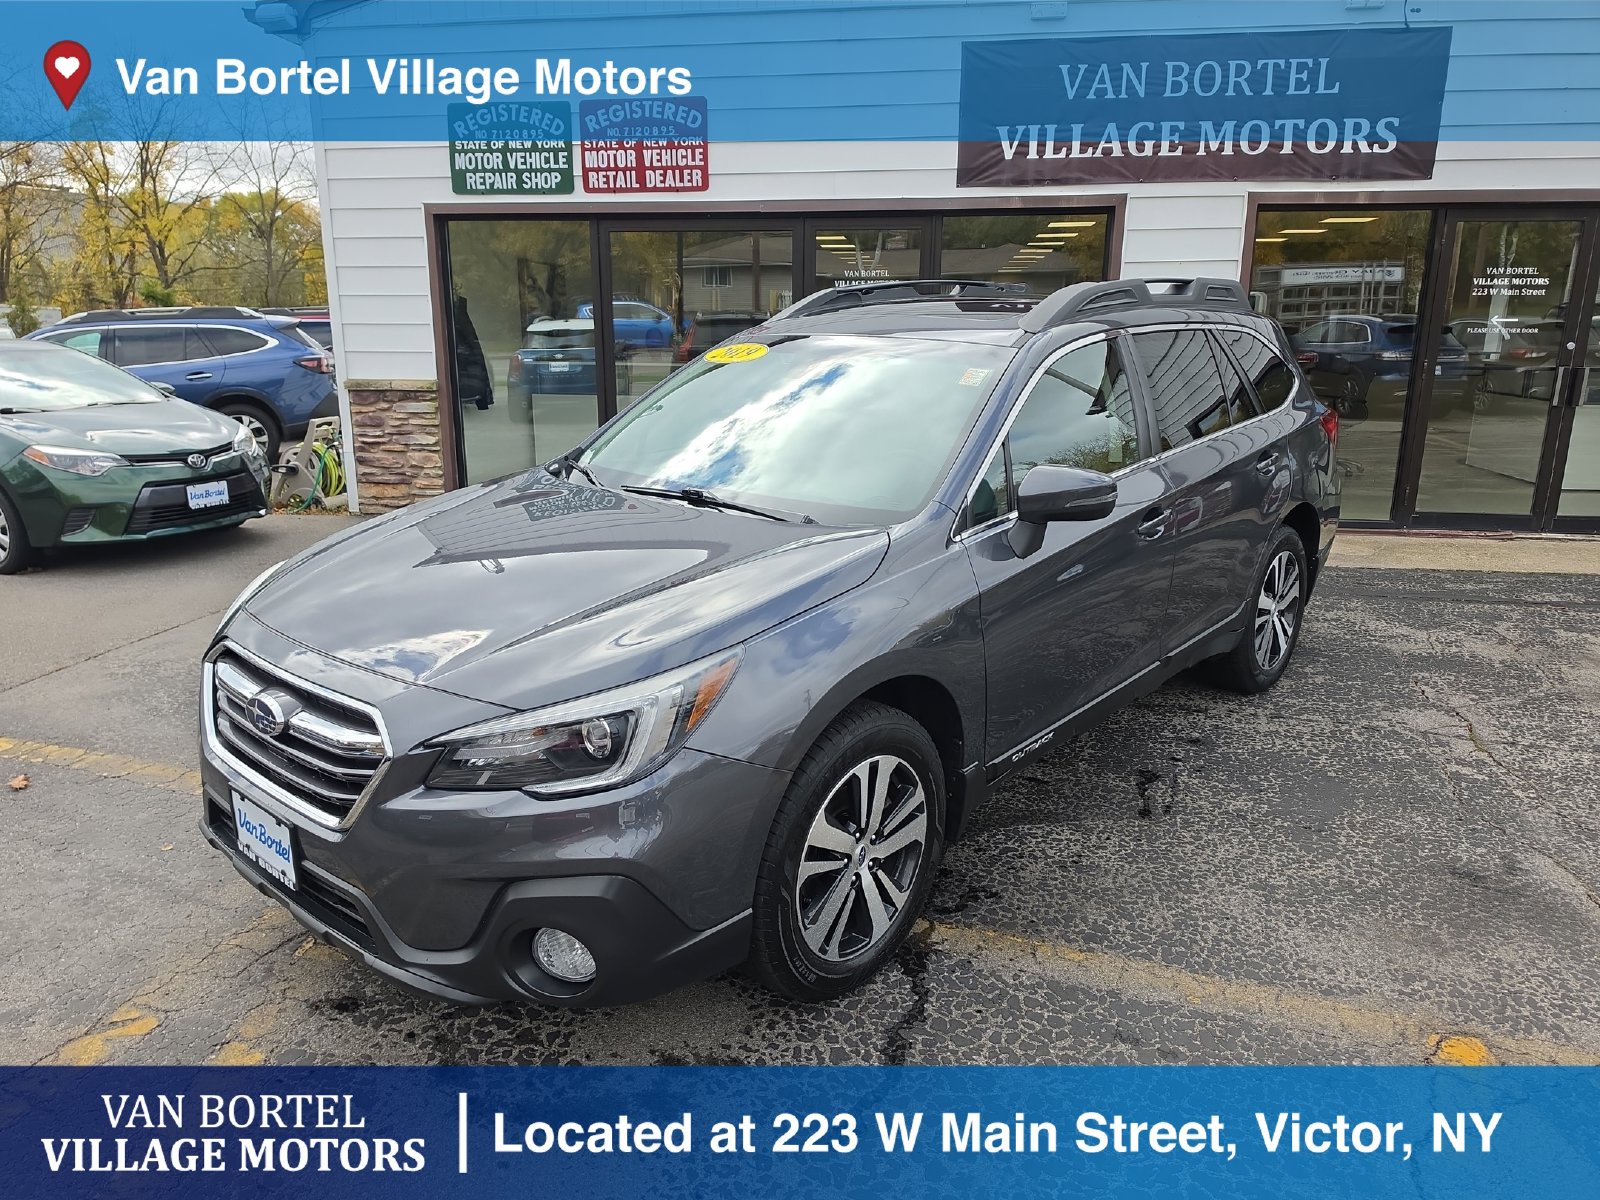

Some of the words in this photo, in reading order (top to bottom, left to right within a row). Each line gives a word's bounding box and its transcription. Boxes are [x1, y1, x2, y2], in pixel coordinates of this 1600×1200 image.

[1058, 61, 1149, 101] VAN
[1162, 57, 1340, 97] BORTEL
[453, 103, 565, 138] REGISTERED
[584, 100, 702, 133] REGISTERED
[455, 140, 488, 150] STATE
[490, 140, 505, 149] OF
[508, 140, 532, 149] NEW
[536, 139, 566, 149] YORK
[584, 138, 619, 149] STATE
[623, 138, 638, 148] OF
[643, 137, 668, 148] NEW
[672, 136, 704, 146] YORK
[995, 121, 1185, 160] VILLAGE
[1195, 116, 1400, 156] MOTORS
[454, 152, 503, 170] MOTOR
[506, 151, 569, 169] VEHICLE
[584, 150, 636, 168] MOTOR
[642, 148, 705, 167] VEHICLE
[466, 172, 517, 190] REPAIR
[522, 172, 562, 189] SHOP
[588, 170, 640, 189] RETAIL
[645, 169, 703, 188] DEALER
[844, 270, 860, 278] VAN
[861, 270, 890, 278] BORTEL
[1486, 267, 1505, 275] VAN
[1505, 267, 1540, 275] BORTEL
[1473, 277, 1510, 286] VILLAGE
[1511, 277, 1550, 286] MOTORS
[1472, 287, 1488, 296] 223
[1489, 287, 1499, 296] W
[1500, 287, 1520, 296] Main
[1521, 287, 1546, 296] Street
